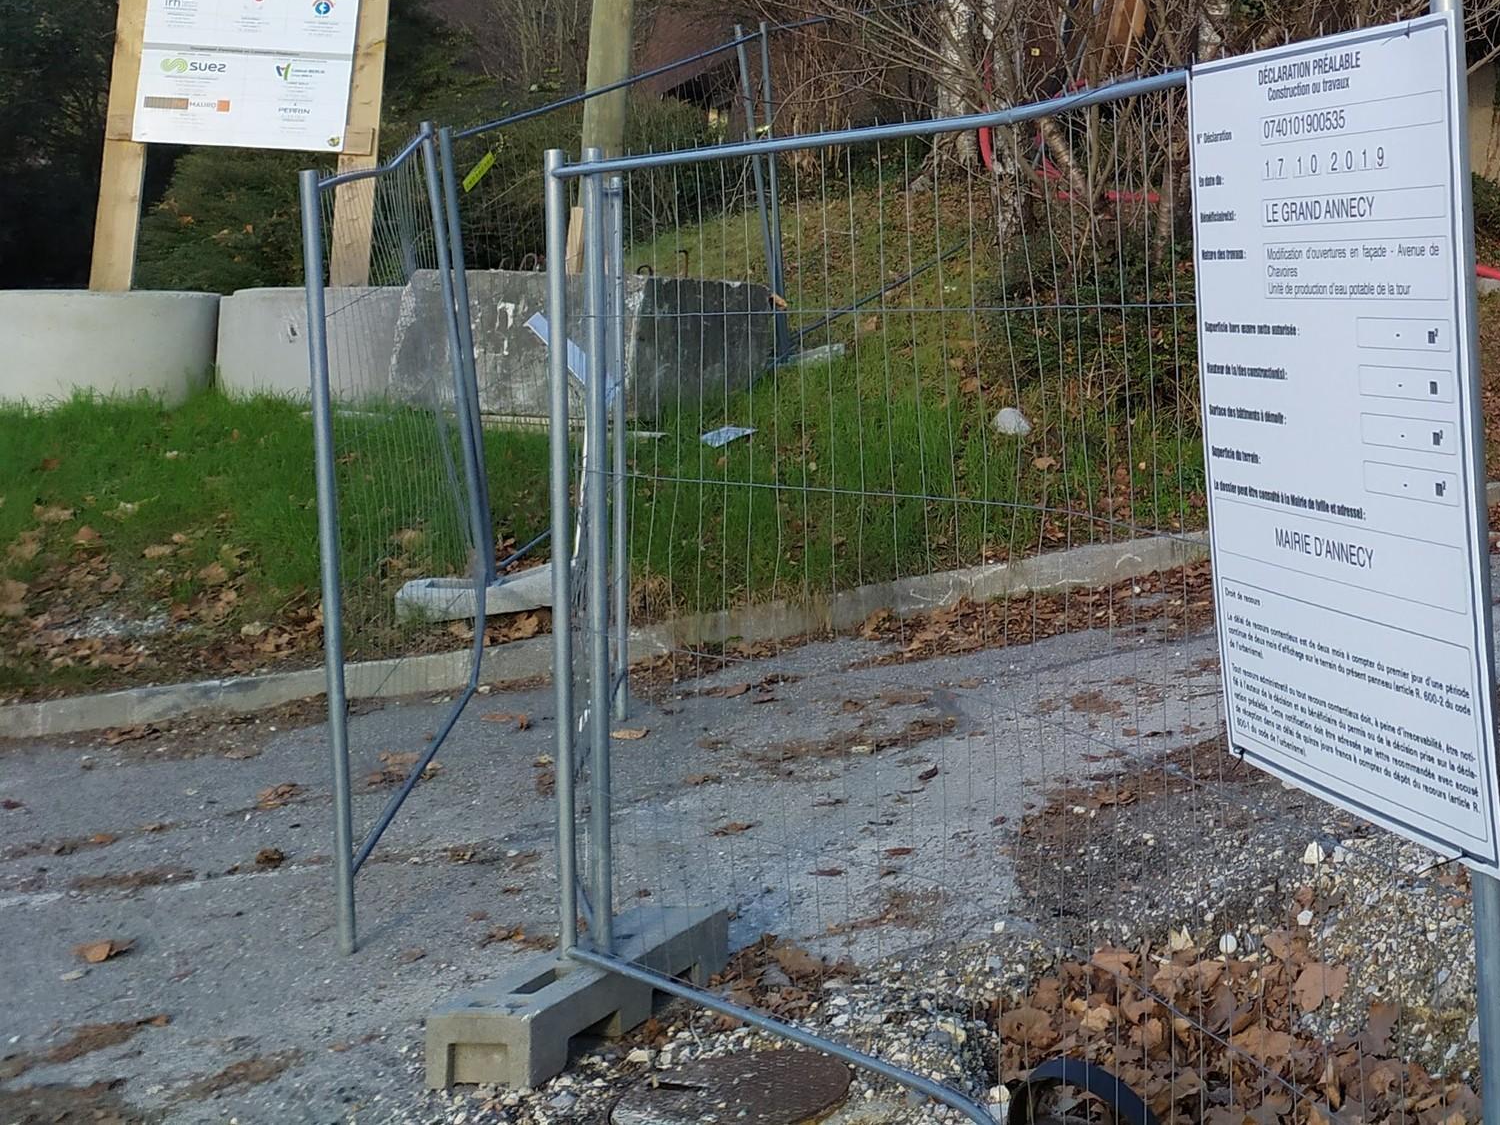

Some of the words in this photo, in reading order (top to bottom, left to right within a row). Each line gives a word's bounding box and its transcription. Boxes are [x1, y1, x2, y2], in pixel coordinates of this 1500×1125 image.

[1258, 61, 1310, 85] DÉCLARATION
[1313, 51, 1360, 75] PRÉALABLE
[1268, 82, 1310, 101] Construction
[1322, 77, 1349, 92] travaux
[1264, 110, 1345, 138] 0740101900535
[1281, 200, 1321, 222] GRAND
[1324, 196, 1374, 218] ANNECY
[1267, 247, 1303, 260] Modification
[1362, 245, 1386, 261] façade
[1398, 244, 1425, 257] Avenue
[1268, 282, 1284, 295] Unité
[1294, 283, 1328, 299] production
[1329, 283, 1347, 295] d'eau
[1349, 283, 1375, 297] potable
[1275, 528, 1311, 554] MAIRIE
[1314, 537, 1373, 568] D'ANNECY
